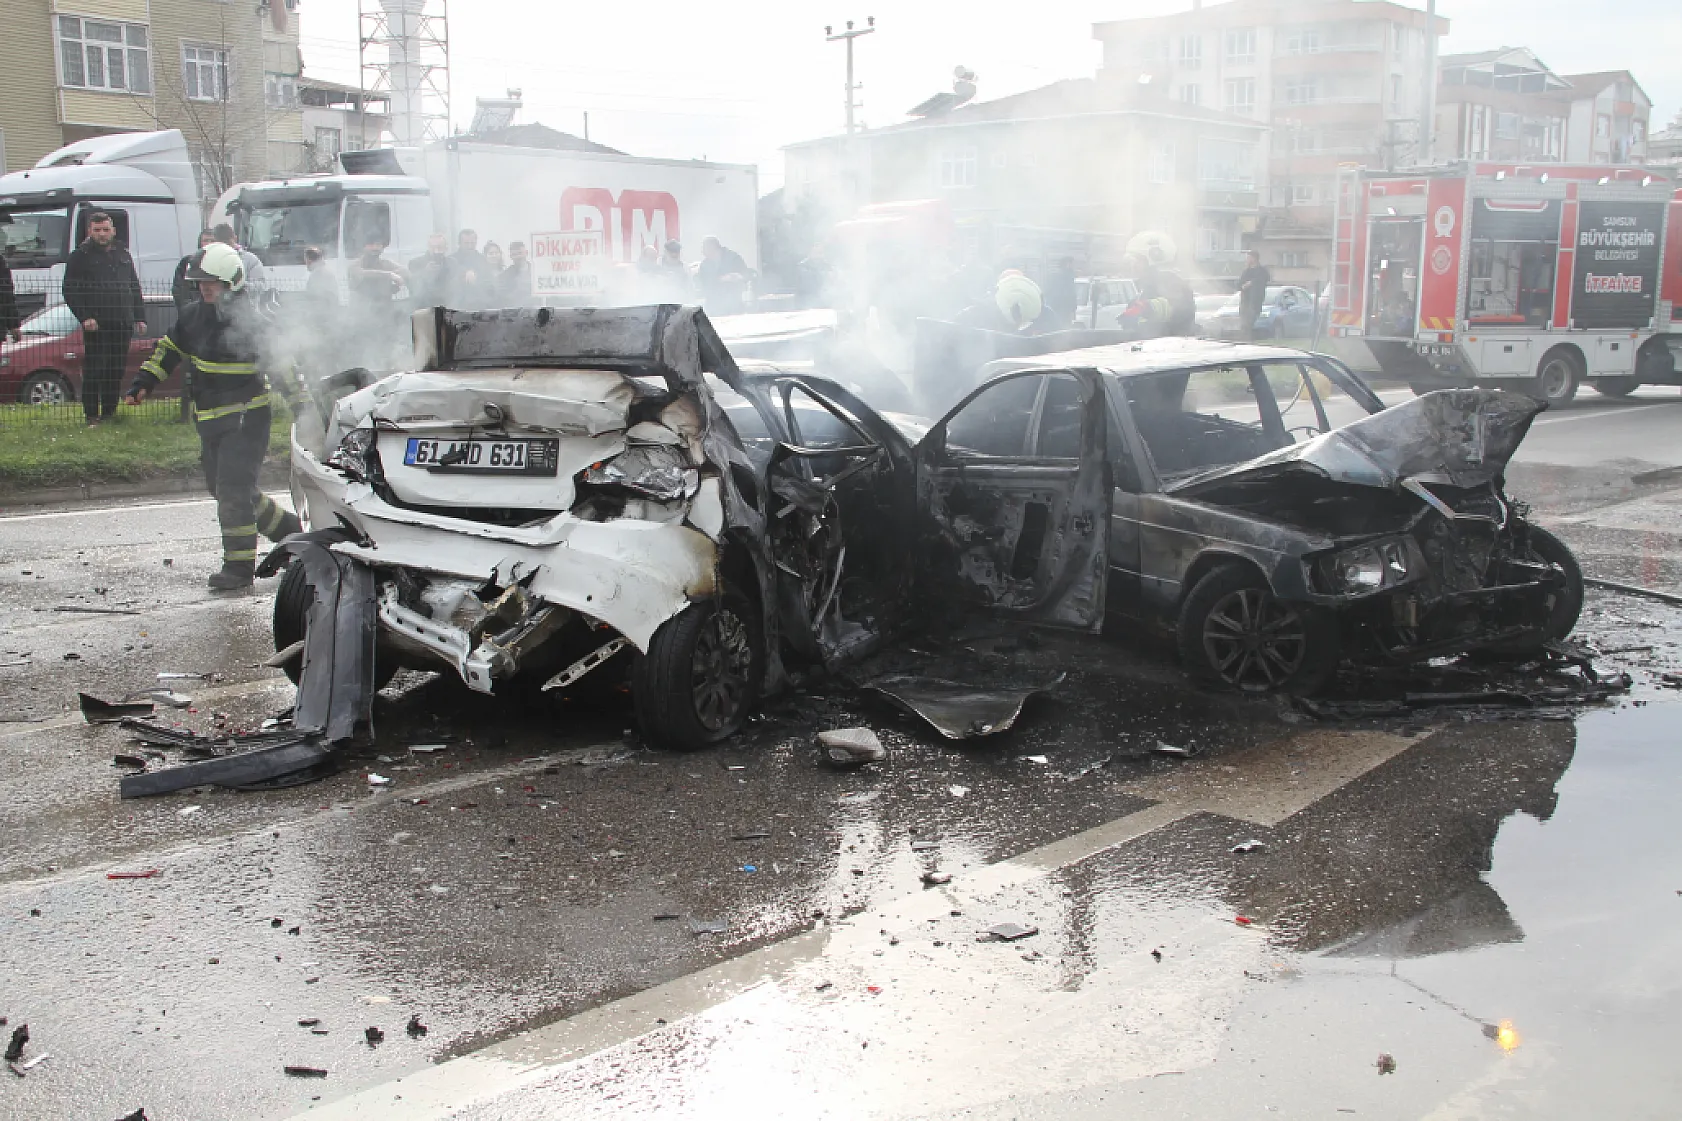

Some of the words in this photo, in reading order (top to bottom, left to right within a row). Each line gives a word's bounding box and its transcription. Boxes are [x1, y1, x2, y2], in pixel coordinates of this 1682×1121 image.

[1602, 216, 1636, 226] SAMSUN
[535, 236, 598, 257] DİKKAT!
[1580, 228, 1654, 247] BÜYÜKŞEHİR
[1585, 272, 1643, 293] İTFAİYE
[417, 440, 438, 463] 61
[490, 444, 524, 466] 631
